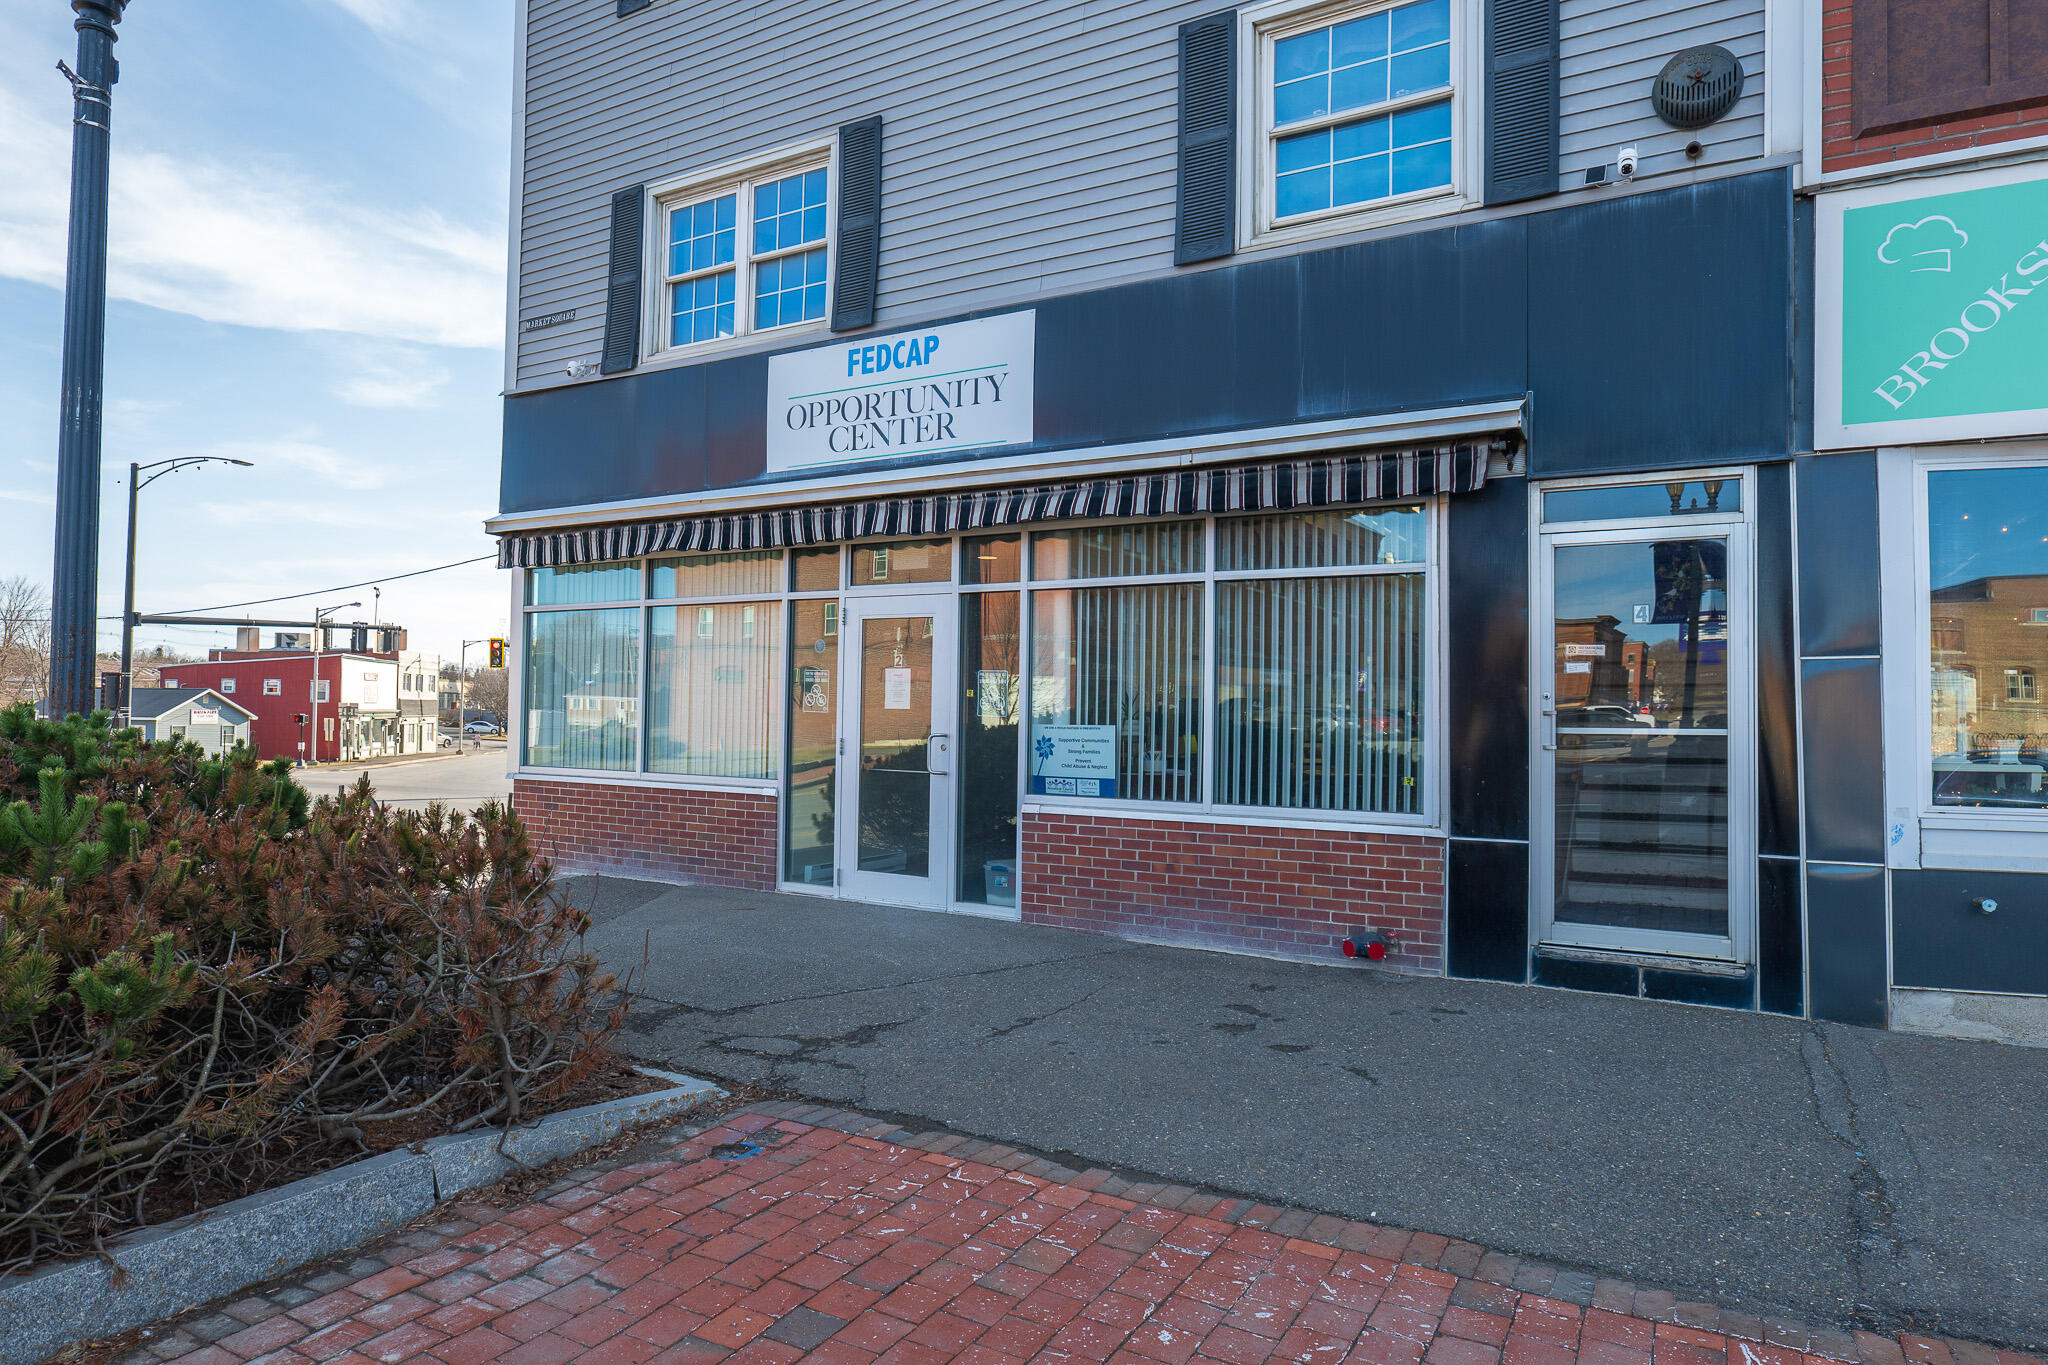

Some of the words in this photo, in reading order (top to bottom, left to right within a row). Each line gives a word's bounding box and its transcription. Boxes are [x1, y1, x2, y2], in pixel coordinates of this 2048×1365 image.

[1873, 240, 2048, 411] BROOKS
[847, 335, 940, 377] FEDCAP
[786, 372, 1008, 431] OPPORTUNITY
[828, 412, 956, 453] CENTER
[1636, 606, 1647, 622] 4
[896, 656, 902, 666] 2
